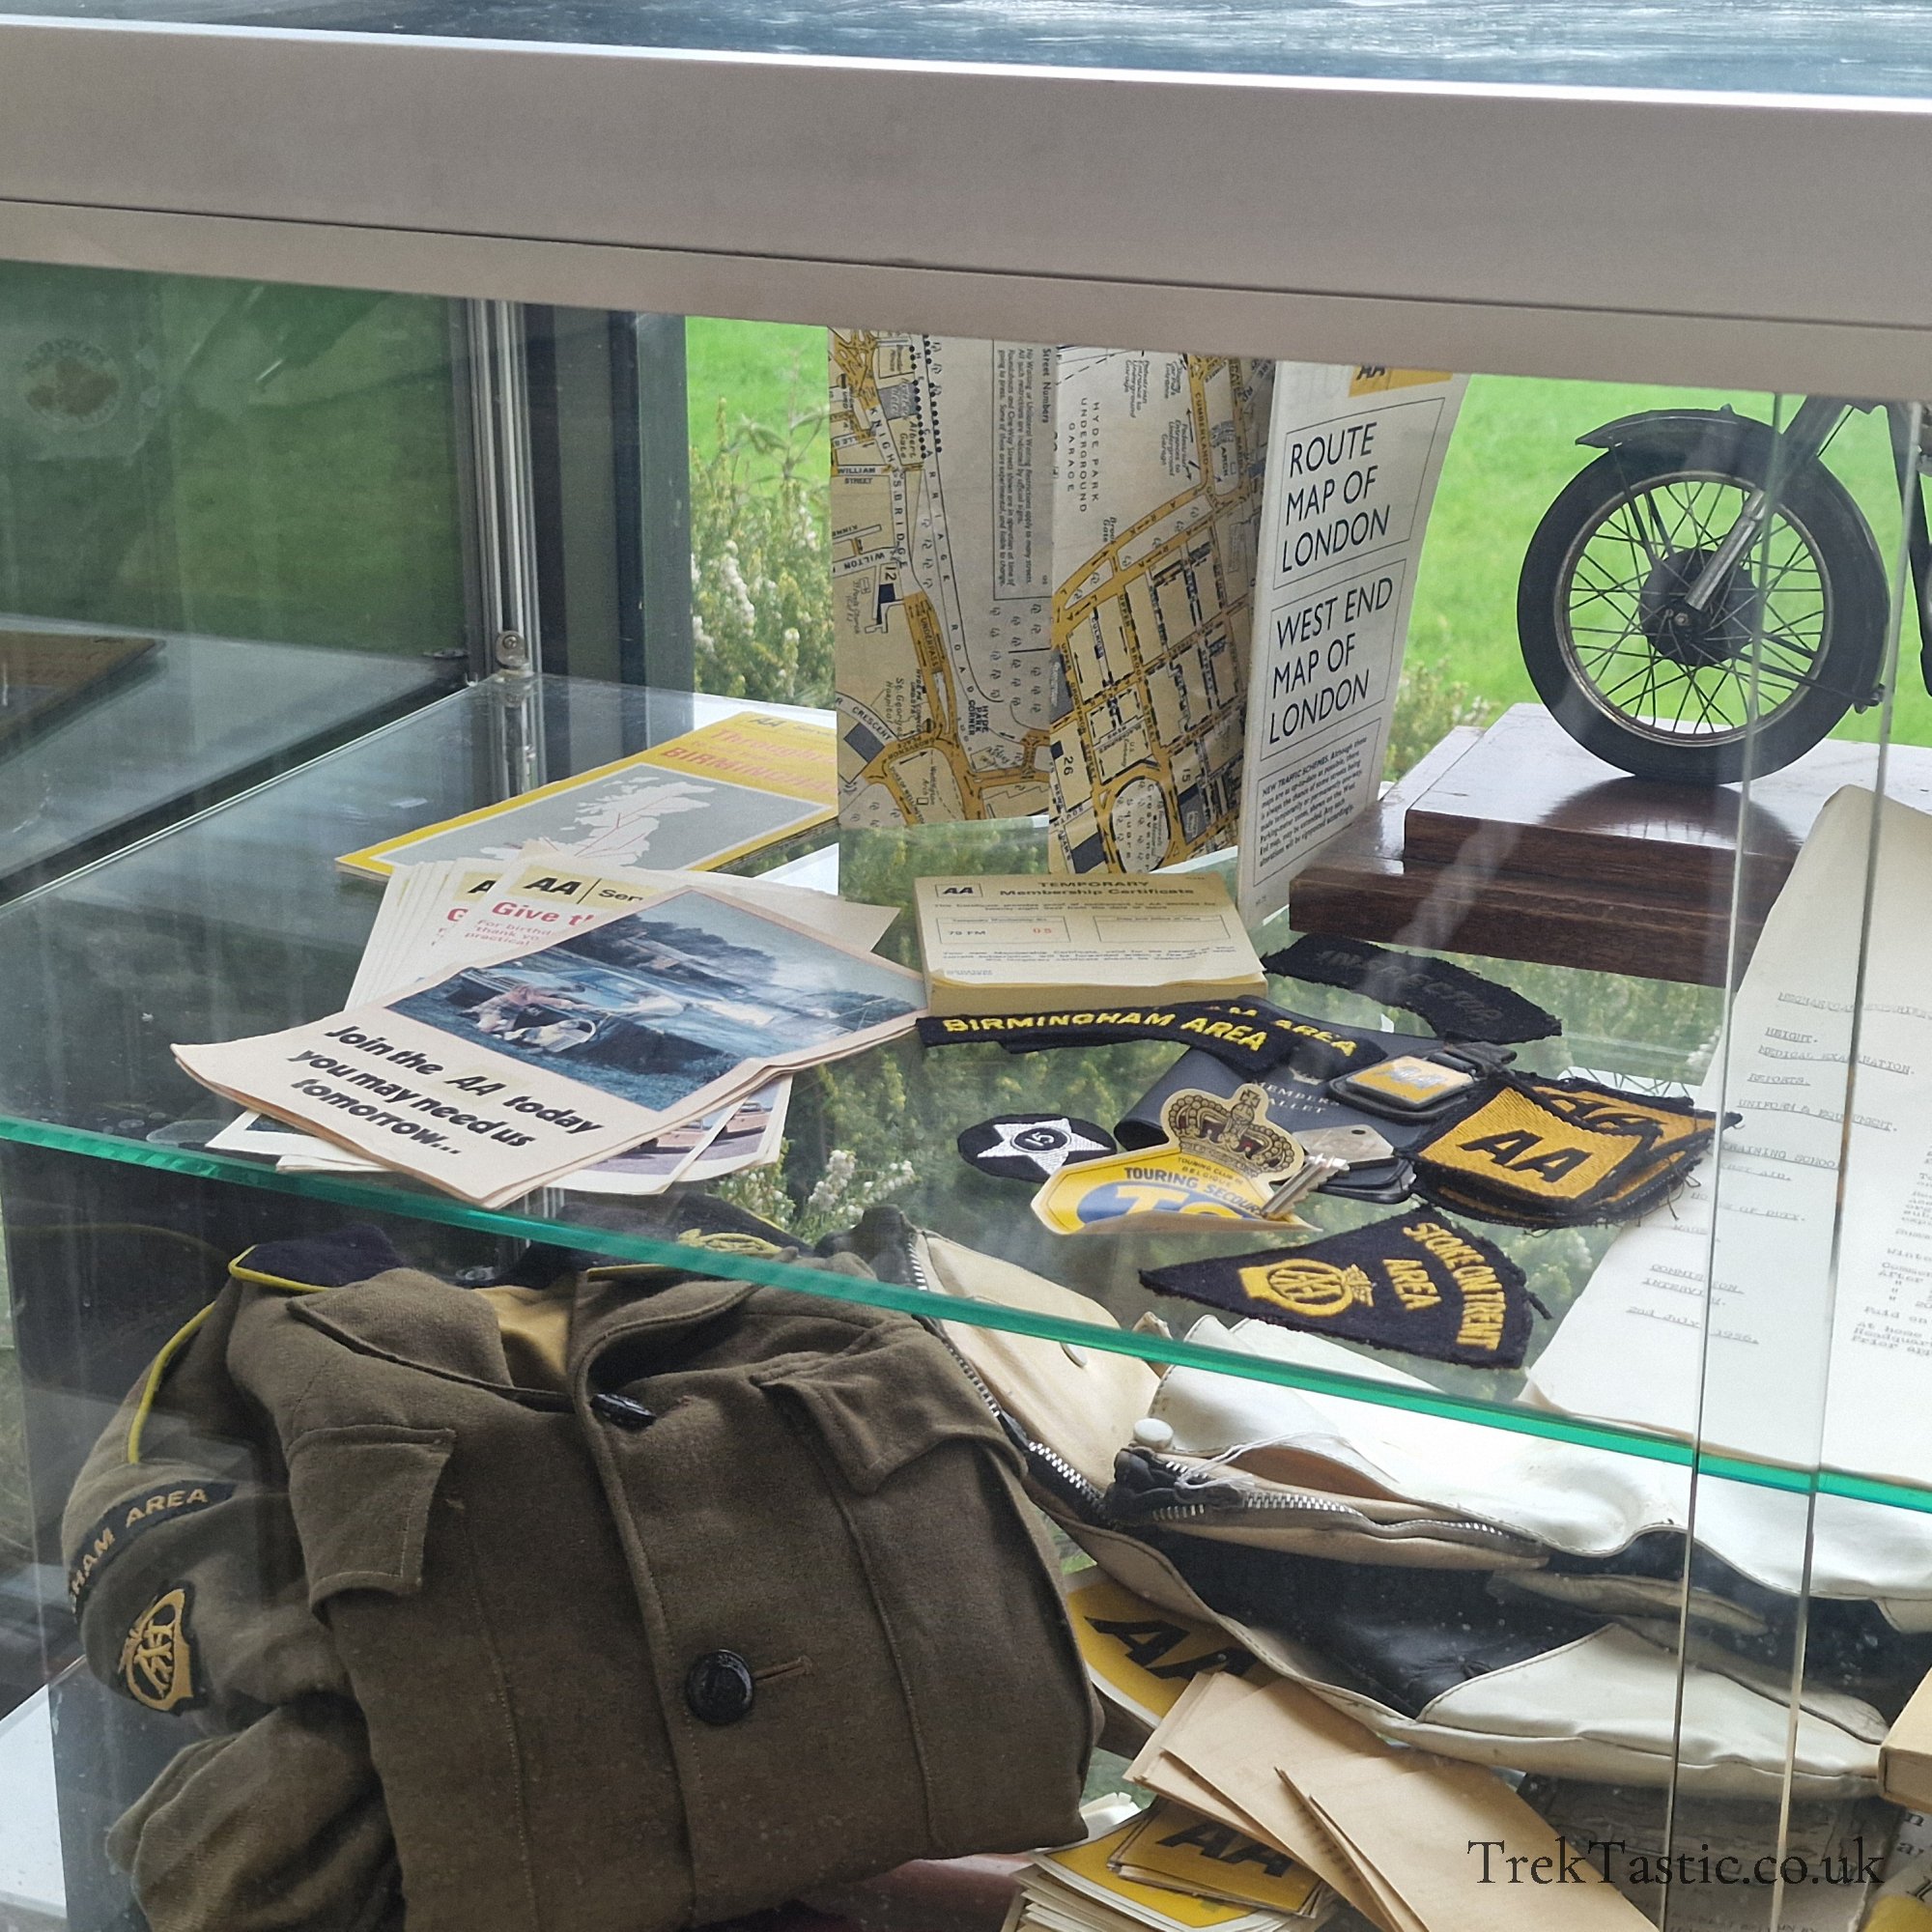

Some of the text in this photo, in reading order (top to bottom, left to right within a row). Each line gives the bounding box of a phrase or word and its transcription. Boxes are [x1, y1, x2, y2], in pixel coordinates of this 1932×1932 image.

[1042, 348, 1051, 377] Street
[1092, 402, 1100, 447] HYDE
[1195, 392, 1208, 465] CUMBERLAND
[1066, 422, 1076, 493] GARAGE
[1079, 397, 1089, 513] UNDERGROUND
[1290, 421, 1378, 478] ROUTE
[1285, 465, 1378, 526] MAP OF
[1282, 503, 1391, 574] LONDON
[844, 553, 886, 570] WILTON
[885, 566, 897, 582] 12
[1119, 594, 1131, 628] UPPER
[1276, 577, 1394, 650] WEST END
[921, 616, 938, 667] UNDERPASS
[1272, 633, 1356, 699] MAP OF
[852, 706, 893, 741] CRESCENT
[1268, 668, 1371, 745] LONDON
[1064, 755, 1074, 777] 26
[1181, 768, 1192, 783] 15
[523, 877, 582, 895] AA
[941, 885, 974, 896] AA
[999, 889, 1103, 897] Membership
[1037, 880, 1151, 889] TEMPORARY
[476, 919, 501, 928] For
[492, 901, 560, 923] Give
[465, 932, 530, 947] practical
[475, 925, 517, 938] thank
[942, 1011, 1269, 1052] BIRMINGHAM AREA
[1757, 1044, 1814, 1061] MEDICAL
[287, 1049, 537, 1148] you may need us
[325, 1025, 605, 1135] Join the AA today
[291, 1077, 463, 1155] tomorrow...
[1268, 1098, 1326, 1114] ALLET
[1026, 1130, 1055, 1148] 15
[1457, 1128, 1593, 1182] AA
[1123, 1166, 1199, 1190] TOURING
[1382, 1259, 1442, 1310] AREA
[1403, 1222, 1507, 1350] STOKE ON TRENT
[126, 1488, 209, 1528] AREA
